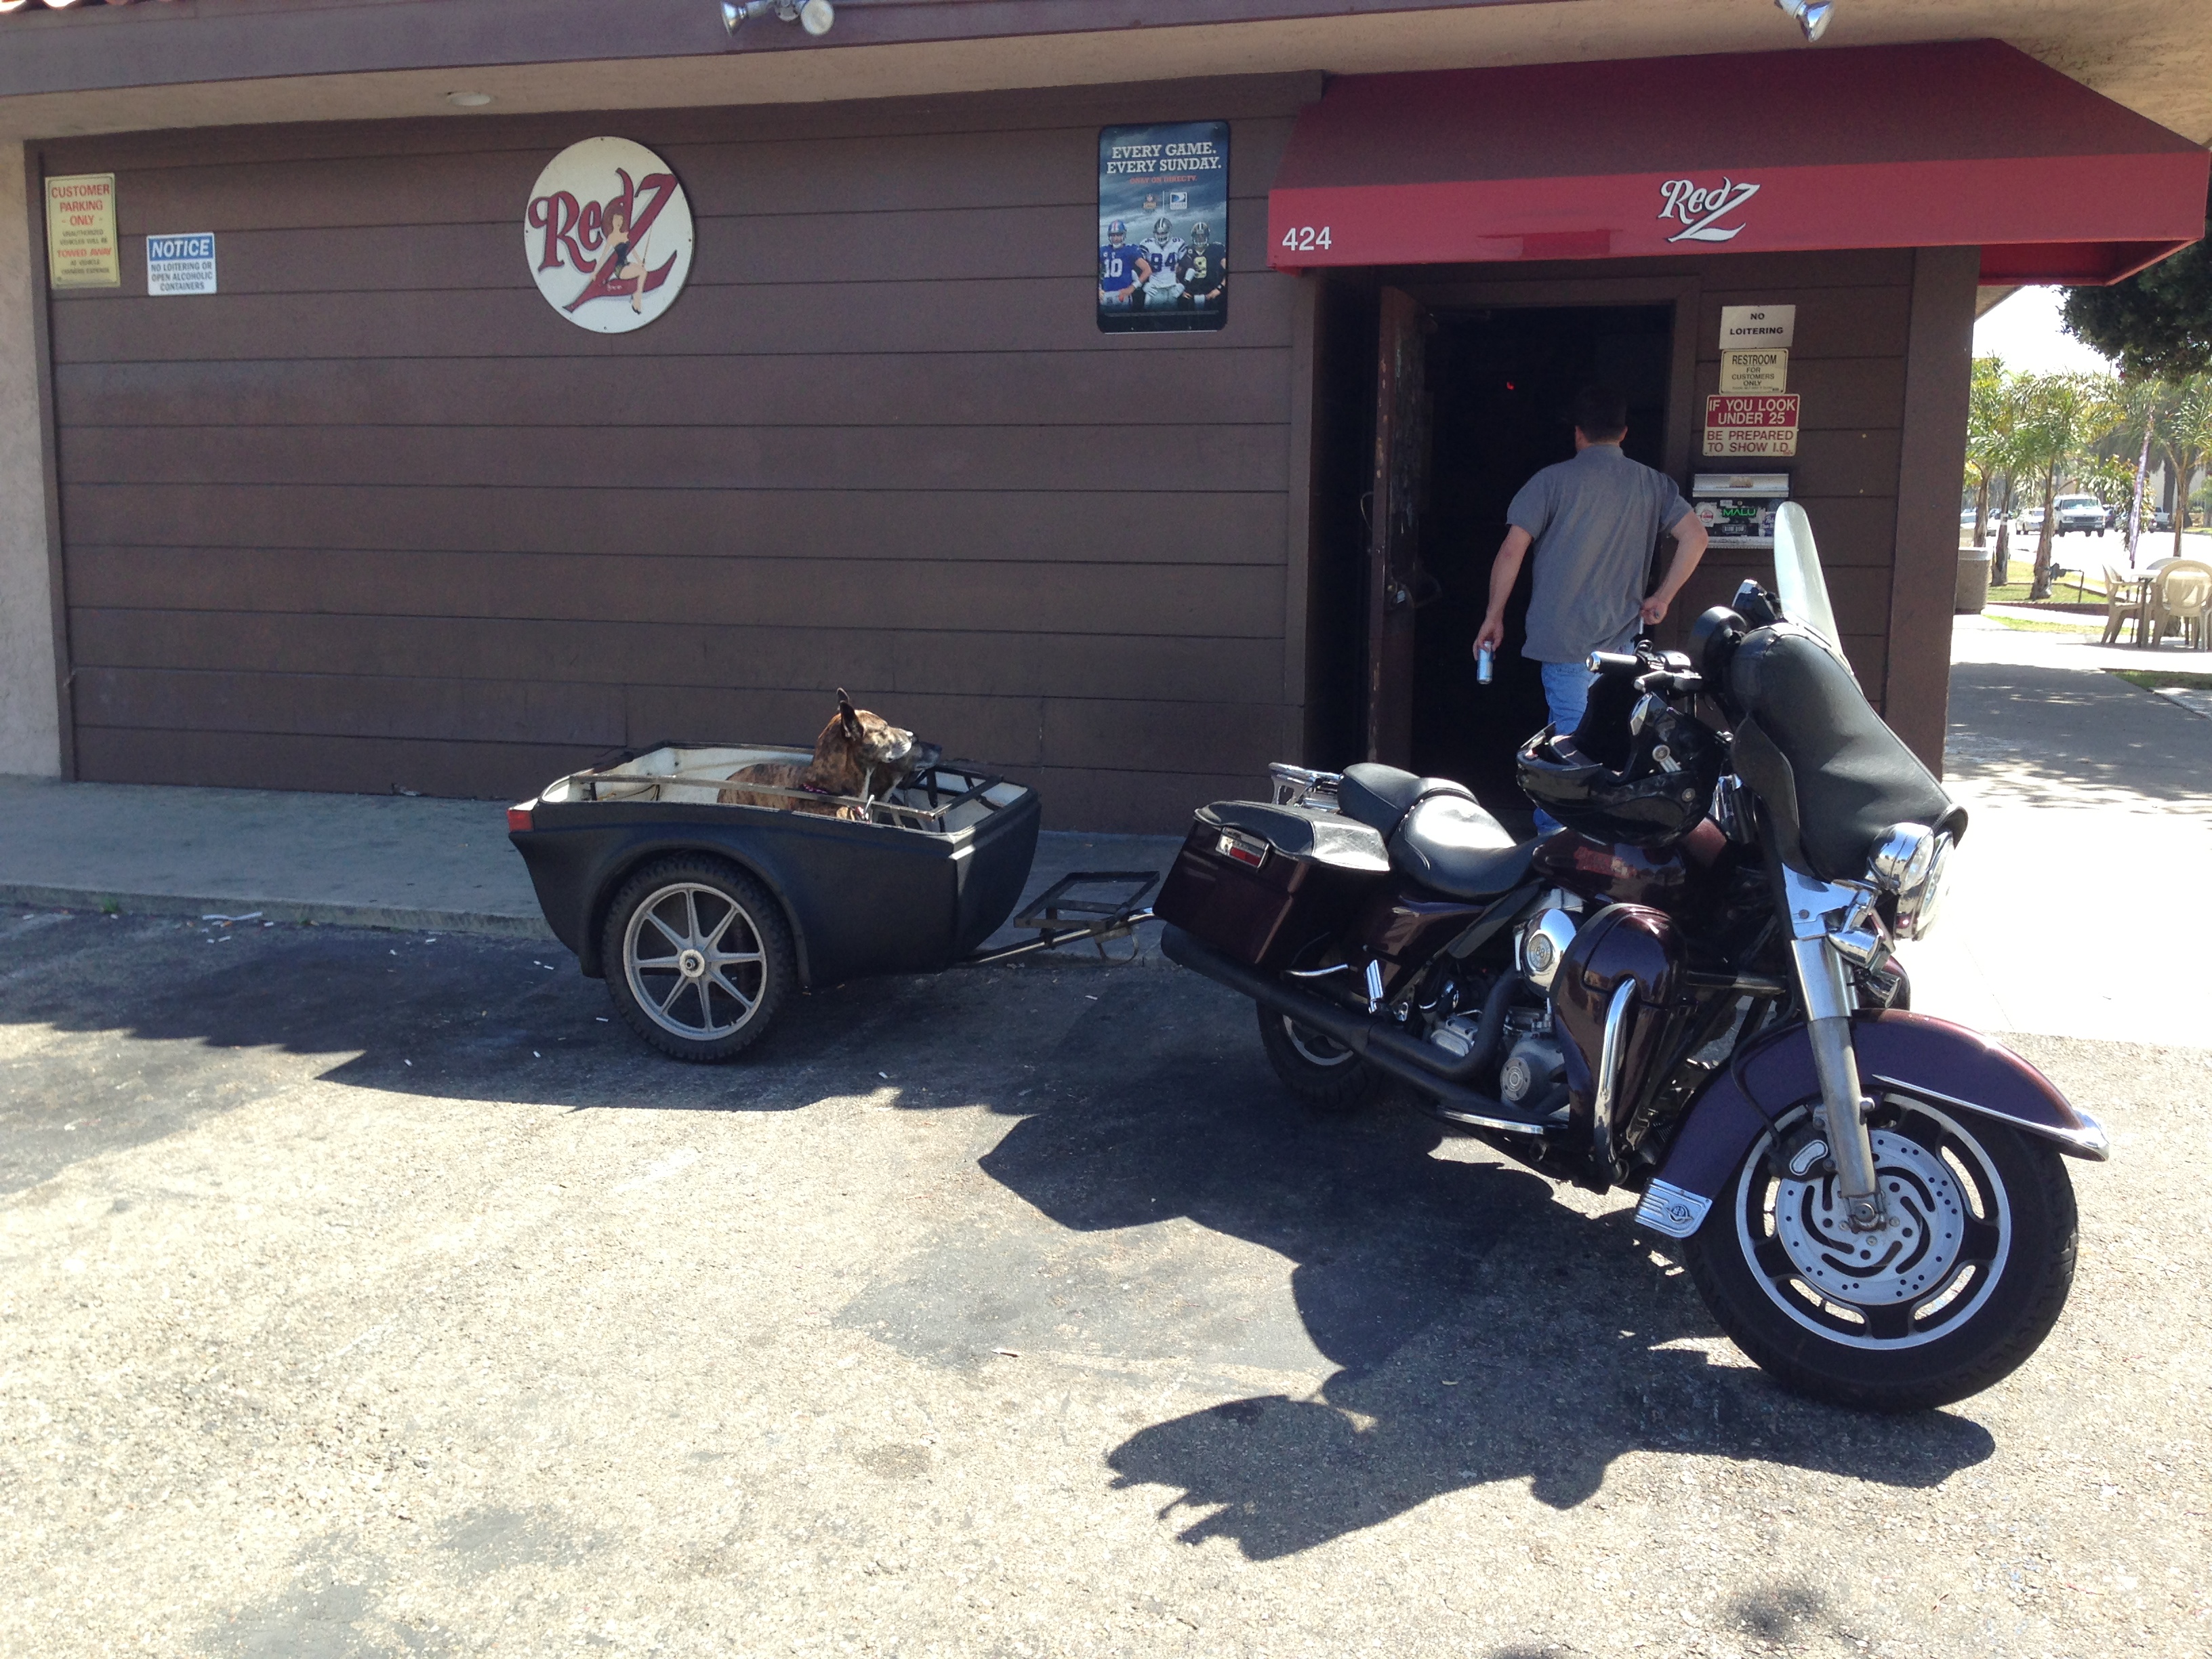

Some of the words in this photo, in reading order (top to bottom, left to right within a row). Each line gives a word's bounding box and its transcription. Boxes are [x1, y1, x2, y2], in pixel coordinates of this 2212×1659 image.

[1111, 144, 1162, 159] EVERY
[1165, 142, 1216, 157] GAME.
[1107, 160, 1157, 174] EVERY
[1160, 157, 1222, 171] SUNDAY.
[52, 184, 110, 199] CUSTOMER
[60, 200, 103, 213] PARKING
[1658, 176, 1761, 243] RedZ
[70, 215, 94, 226] ONLY
[1282, 226, 1332, 251] 424
[57, 249, 87, 258] TOWED
[152, 239, 210, 258] NOTICE
[151, 264, 161, 272] NO
[163, 262, 199, 271] LOITERING
[202, 261, 212, 270] OR
[1104, 258, 1122, 278] 10
[1152, 253, 1176, 272] 94
[151, 273, 171, 282] OPEN
[173, 271, 213, 281] ALCOHOLIC
[160, 281, 205, 291] CONTAINERS
[1729, 327, 1784, 335] LOITERING
[1732, 354, 1777, 365] RESTROOM
[1708, 399, 1721, 411] IF
[1726, 398, 1753, 411] YOU
[1758, 398, 1795, 411] LOOK
[1718, 413, 1763, 425] UNDER
[1769, 412, 1785, 424] 25
[1707, 430, 1723, 441] BE
[1729, 430, 1793, 441] PREPARED
[1707, 443, 1724, 453] TO
[1729, 443, 1768, 453] SHOW
